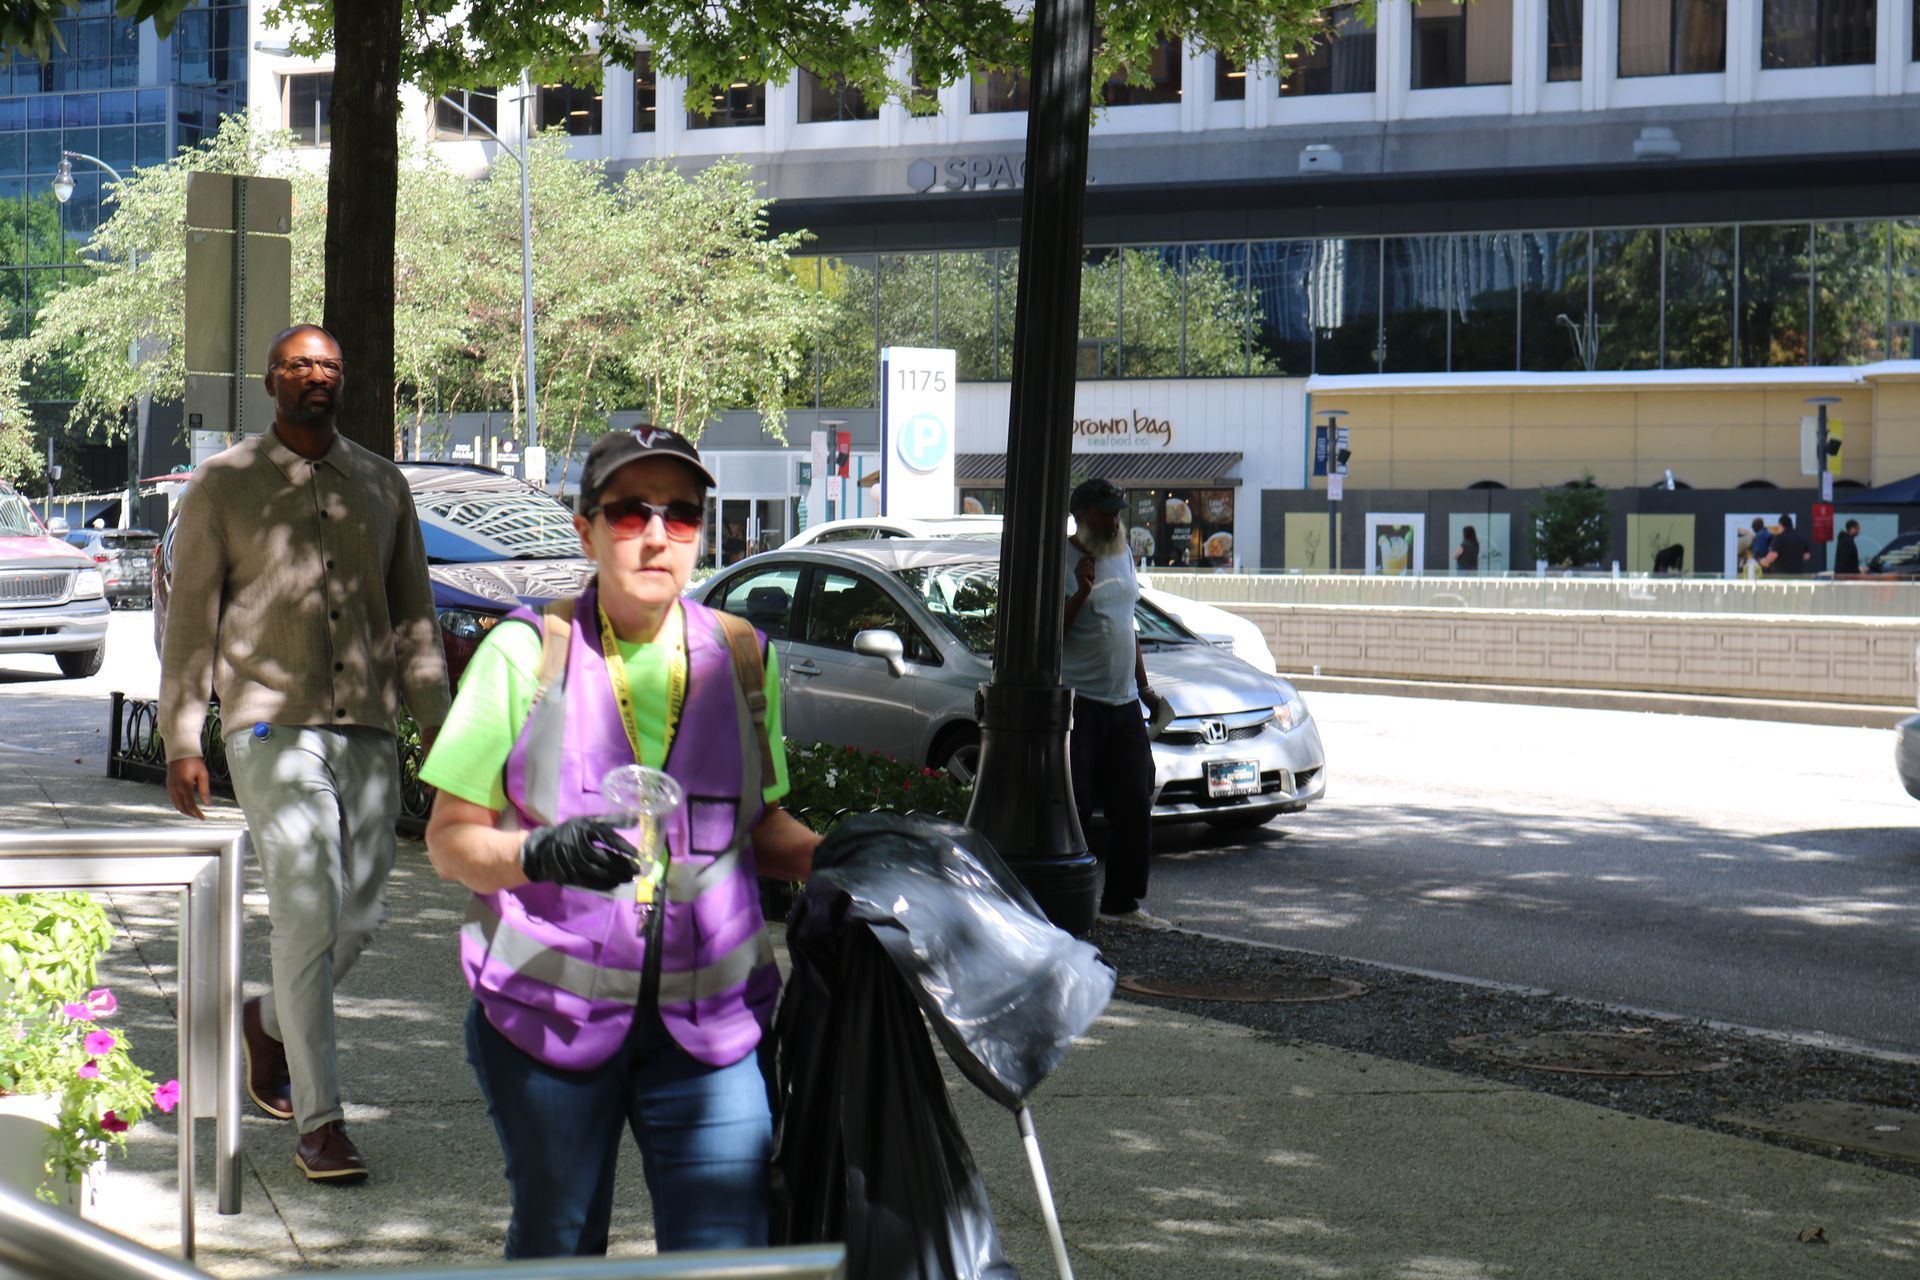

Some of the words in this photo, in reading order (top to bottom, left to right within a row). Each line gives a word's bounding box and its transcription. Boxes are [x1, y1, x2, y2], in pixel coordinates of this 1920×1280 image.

[897, 368, 947, 392] 1175
[912, 418, 941, 459] P
[1087, 433, 1132, 446] seafood
[1133, 408, 1172, 447] bag
